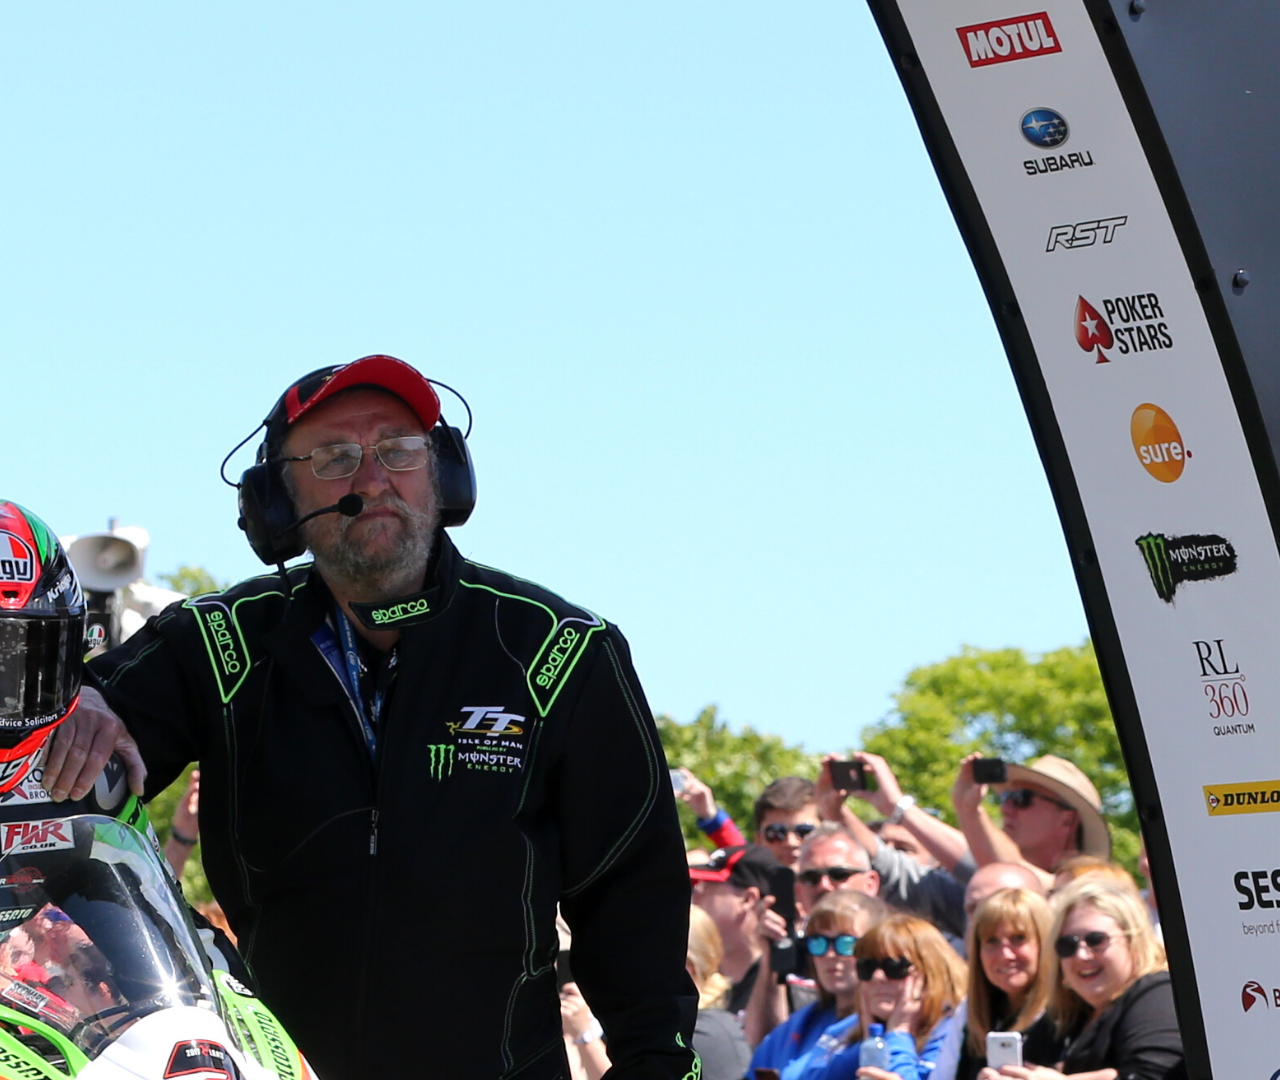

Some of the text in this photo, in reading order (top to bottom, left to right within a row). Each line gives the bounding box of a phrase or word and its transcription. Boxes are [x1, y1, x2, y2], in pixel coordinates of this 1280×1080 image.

[967, 19, 1055, 62] MOTUL
[1024, 151, 1092, 175] SUBARU
[1046, 216, 1128, 252] RST
[1103, 293, 1164, 325] POKER
[1115, 322, 1173, 354] STARS
[1169, 543, 1230, 563] MONSTER
[1183, 562, 1224, 572] ENERGY
[46, 573, 73, 603] Kriega
[372, 599, 428, 623] sparco
[206, 611, 241, 674] sparco
[535, 628, 577, 688] sparco
[1192, 639, 1240, 677] RL
[1205, 682, 1250, 719] 360
[24, 713, 59, 727] Solicitors
[461, 706, 526, 737] TT
[1213, 723, 1255, 736] QUANTUM
[501, 741, 523, 749] MAN
[458, 751, 522, 768] MONSTER
[467, 763, 513, 773] ENERGY
[29, 791, 51, 799] BROK
[3, 821, 72, 851] FWR
[1242, 921, 1275, 938] beyond
